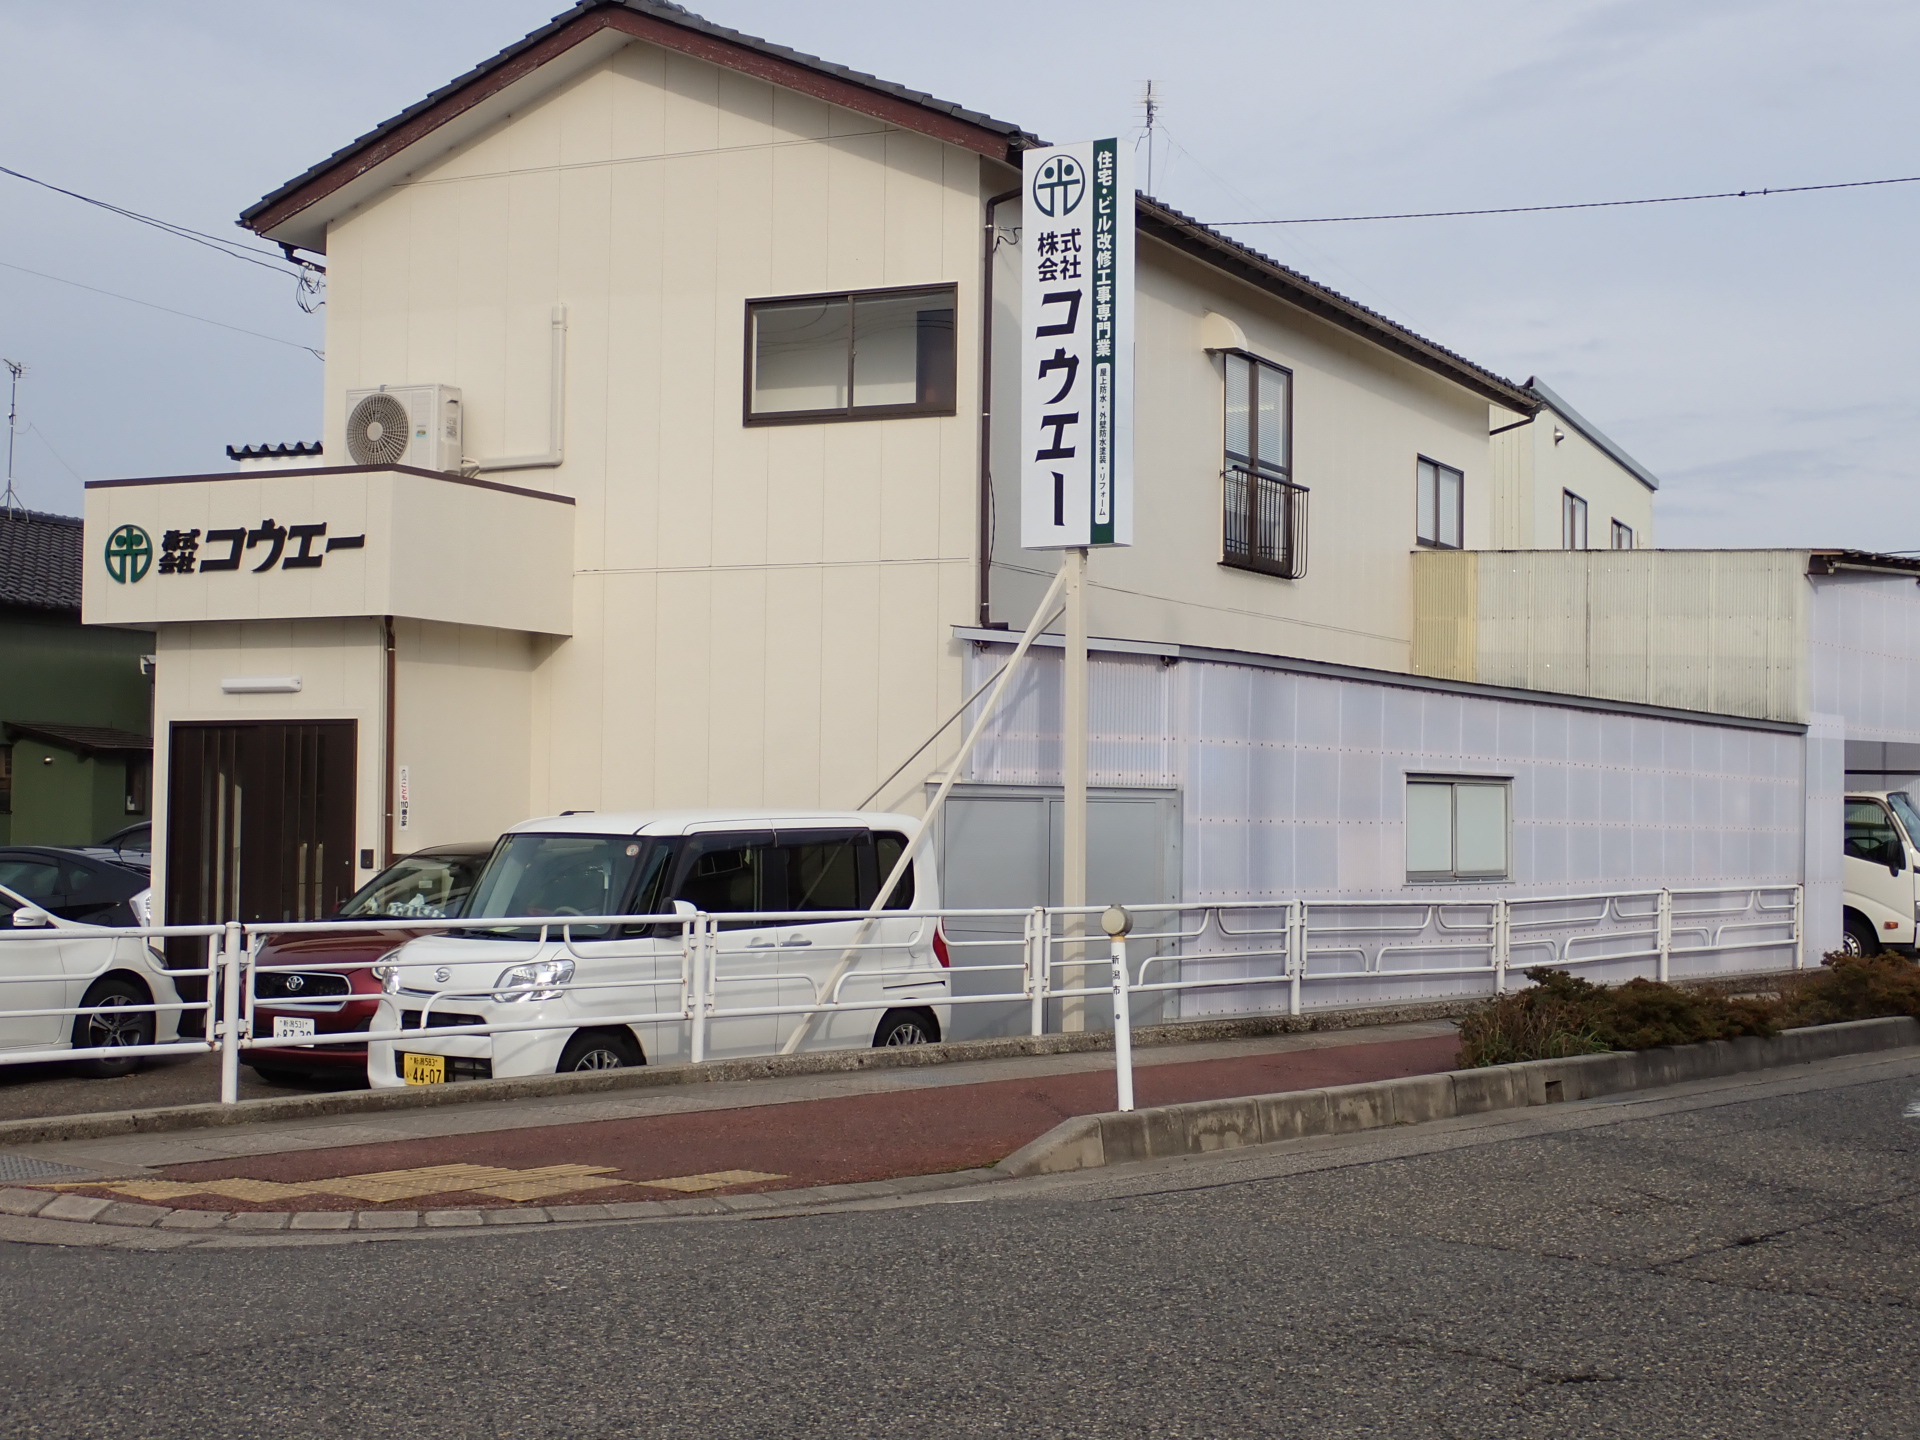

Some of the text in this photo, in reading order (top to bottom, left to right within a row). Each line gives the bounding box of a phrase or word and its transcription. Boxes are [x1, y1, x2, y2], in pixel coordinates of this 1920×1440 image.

[1037, 228, 1082, 257] 株式
[1037, 254, 1082, 283] 会社
[1035, 288, 1083, 527] コウエー
[199, 518, 366, 573] コウエー
[157, 551, 197, 574] 会社
[1111, 954, 1121, 996] 新潟市
[412, 1067, 442, 1084] 44-07
